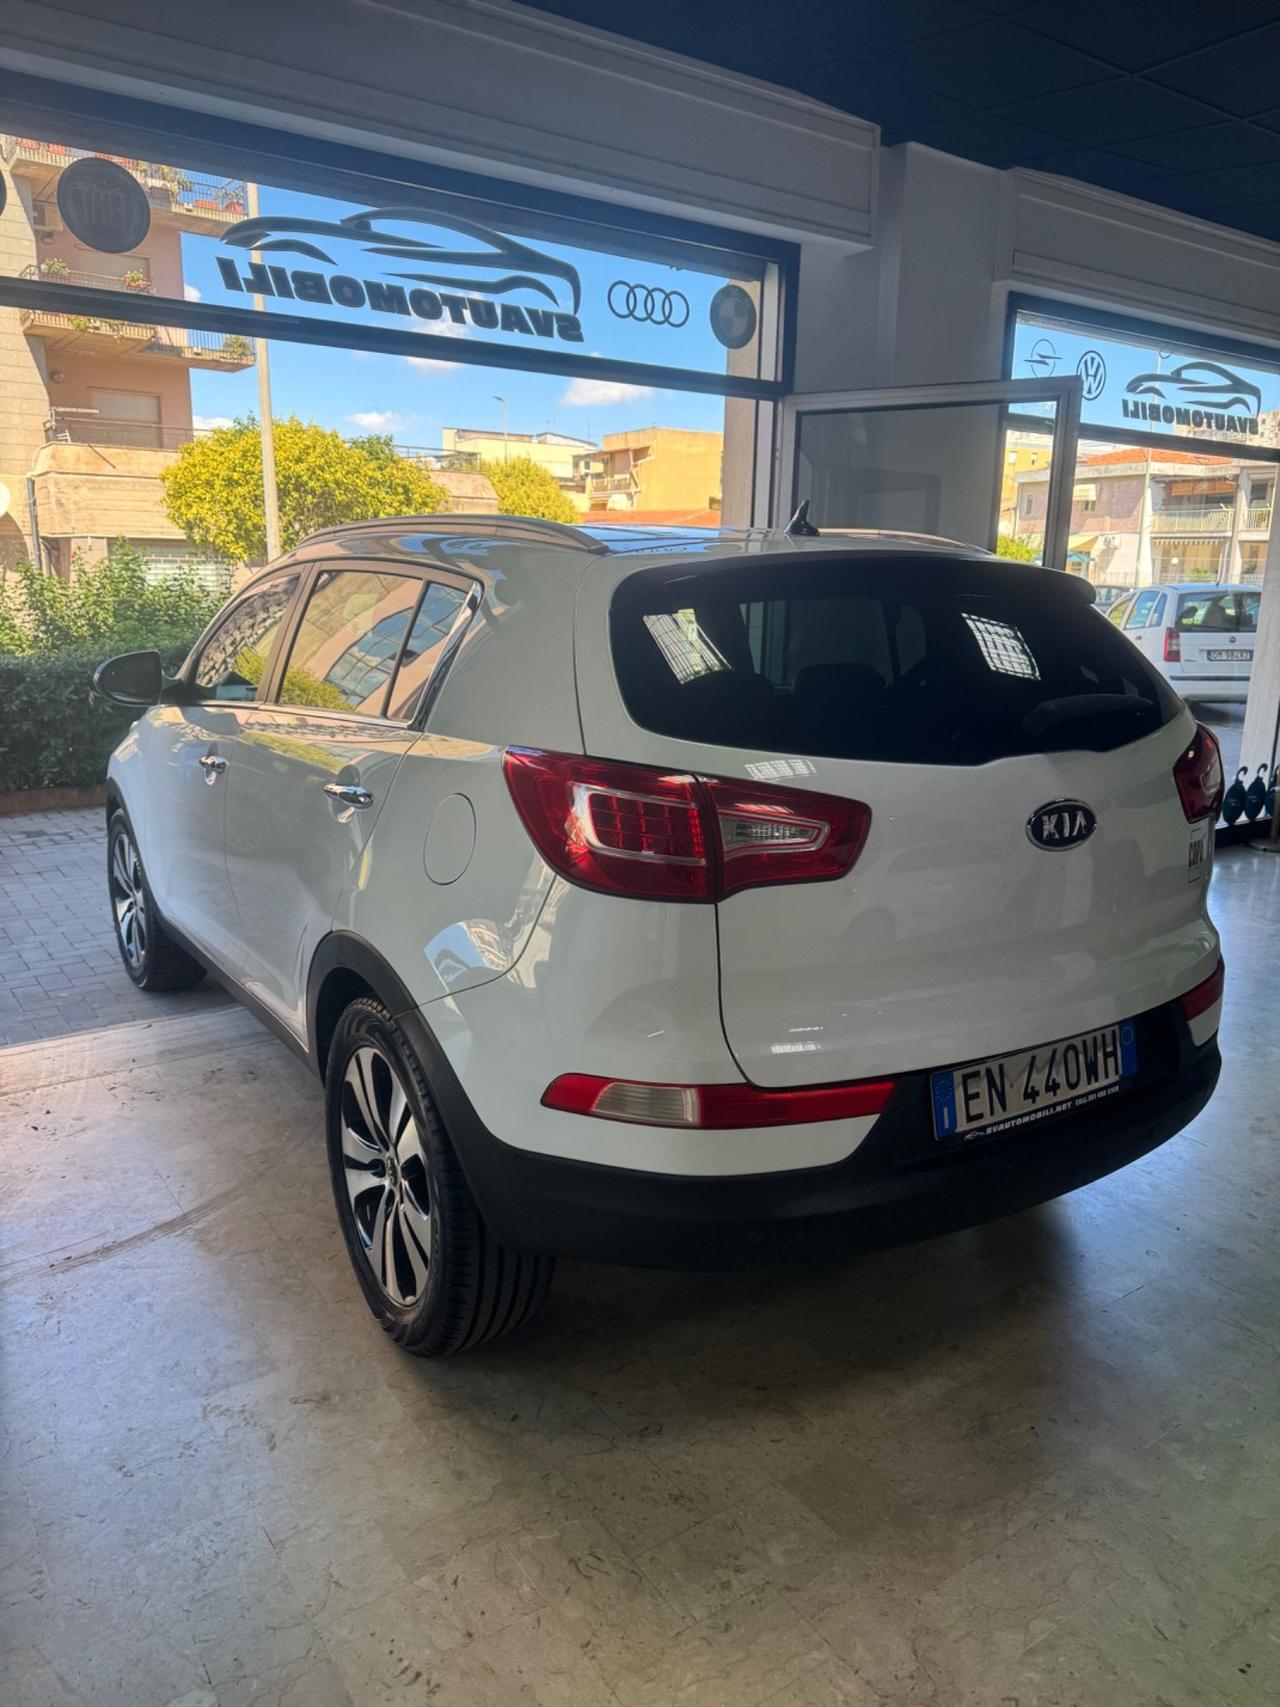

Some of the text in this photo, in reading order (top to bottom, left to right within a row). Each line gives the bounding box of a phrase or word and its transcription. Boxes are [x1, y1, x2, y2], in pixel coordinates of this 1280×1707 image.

[1041, 811, 1087, 840] KIA
[963, 1030, 1119, 1123] EN 440WH
[985, 1102, 1073, 1135] SVAUTOMOBILI.NET
